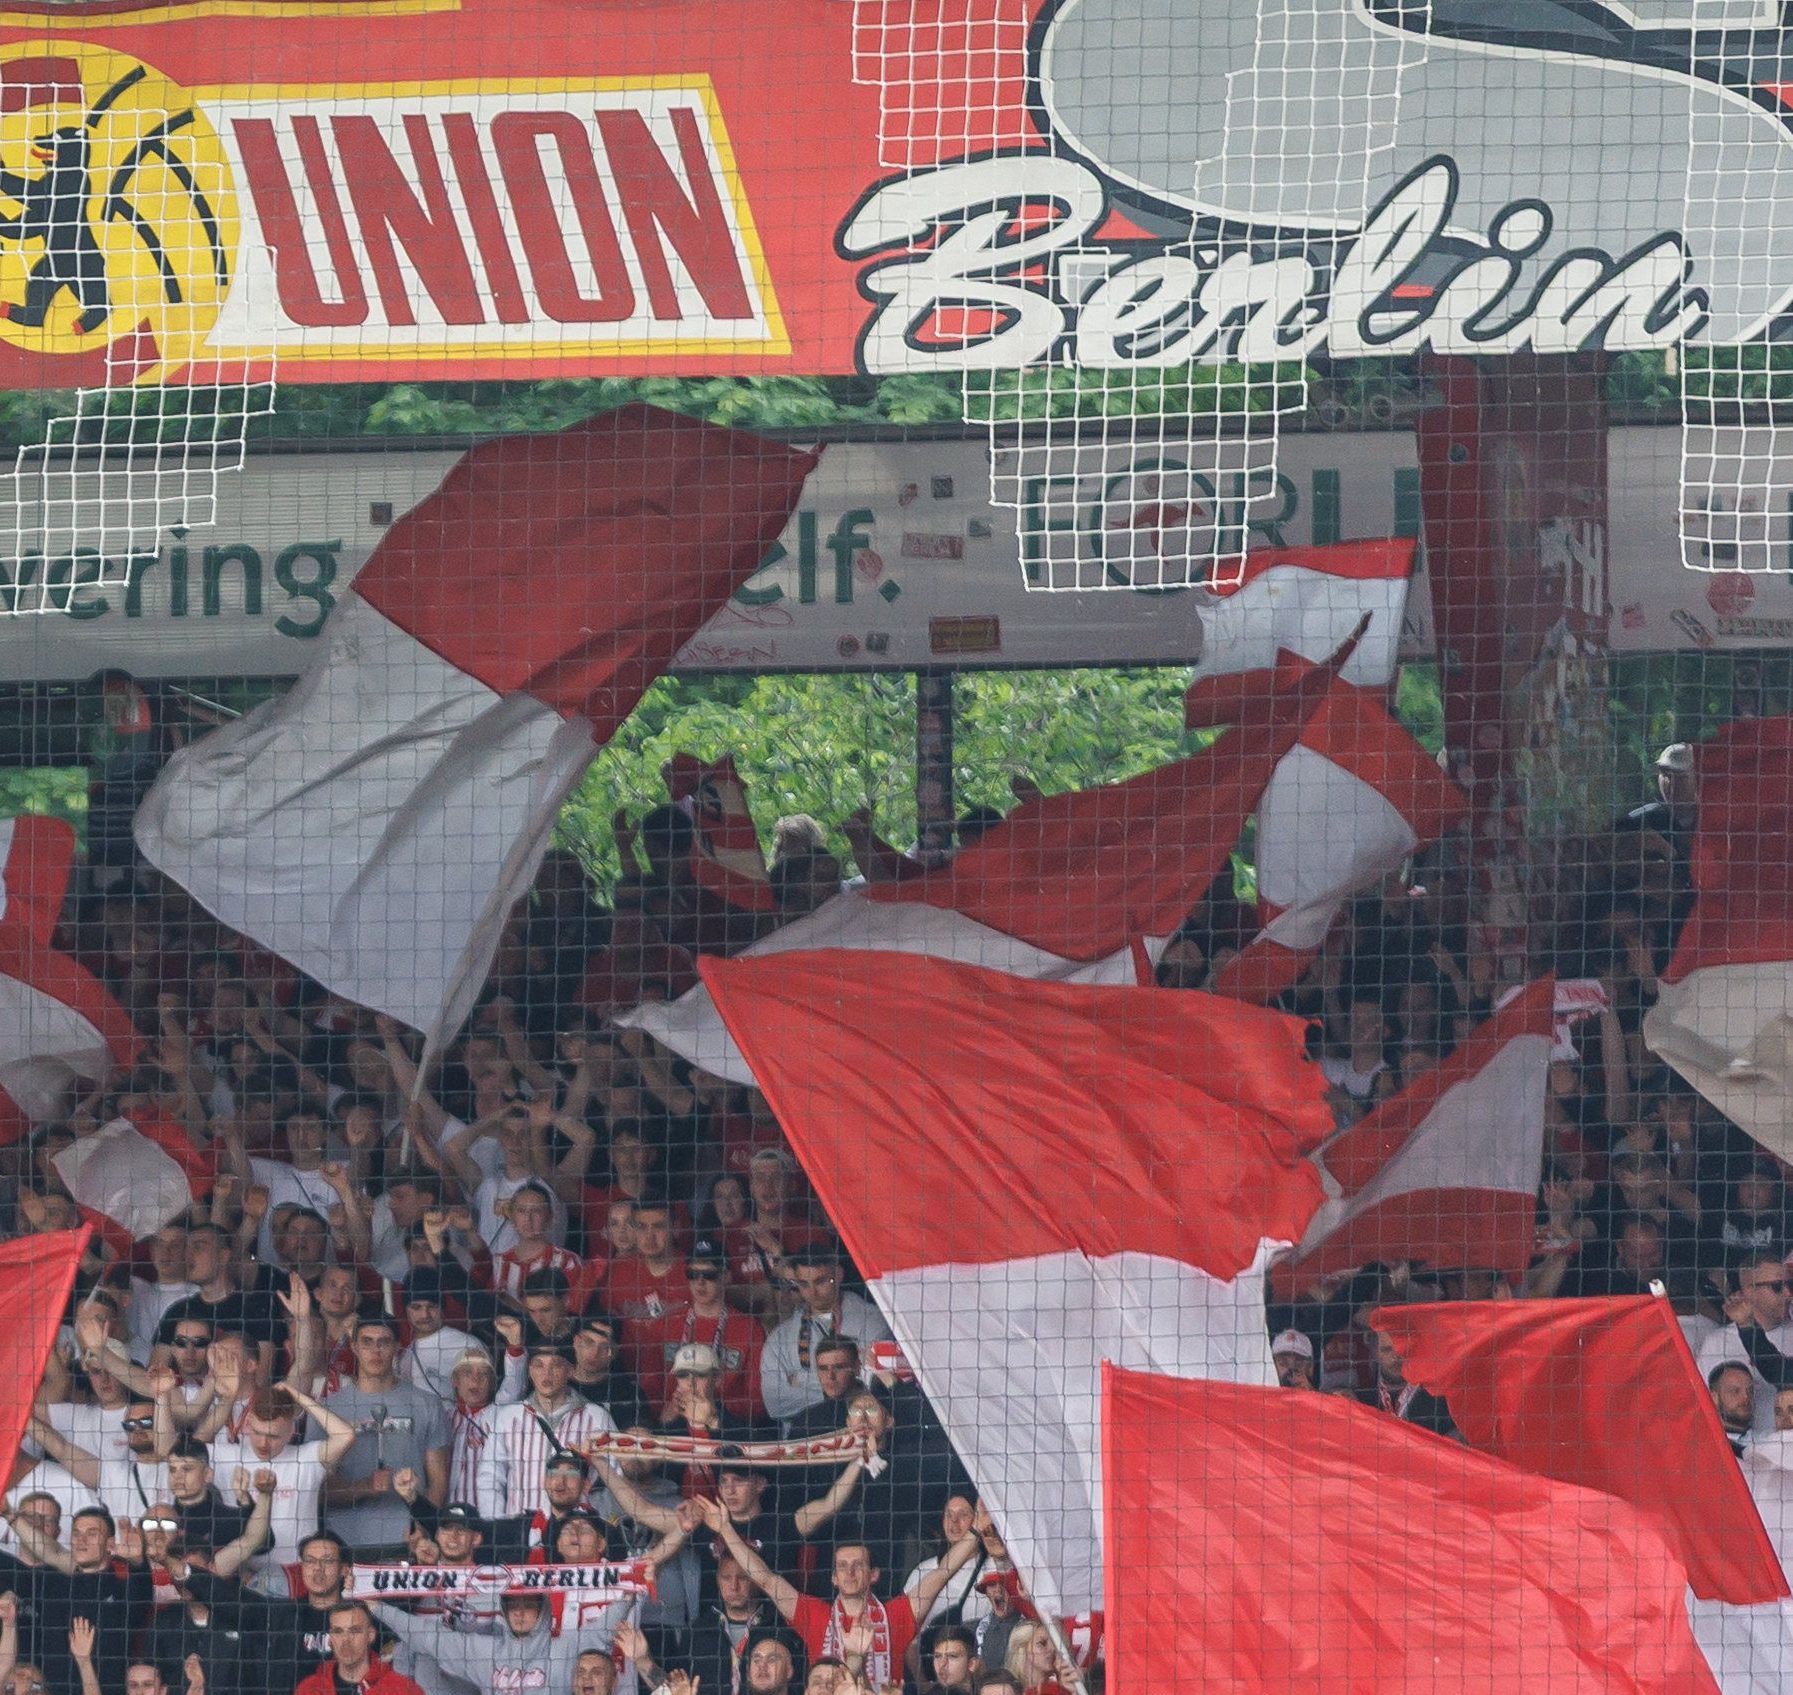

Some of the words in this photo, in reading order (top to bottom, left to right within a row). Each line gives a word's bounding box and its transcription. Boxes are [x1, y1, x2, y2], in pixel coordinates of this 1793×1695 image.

[229, 105, 756, 328] UNION
[834, 155, 1704, 375] Berlin
[372, 1569, 457, 1592] UNION
[523, 1565, 621, 1590] BERLIN
